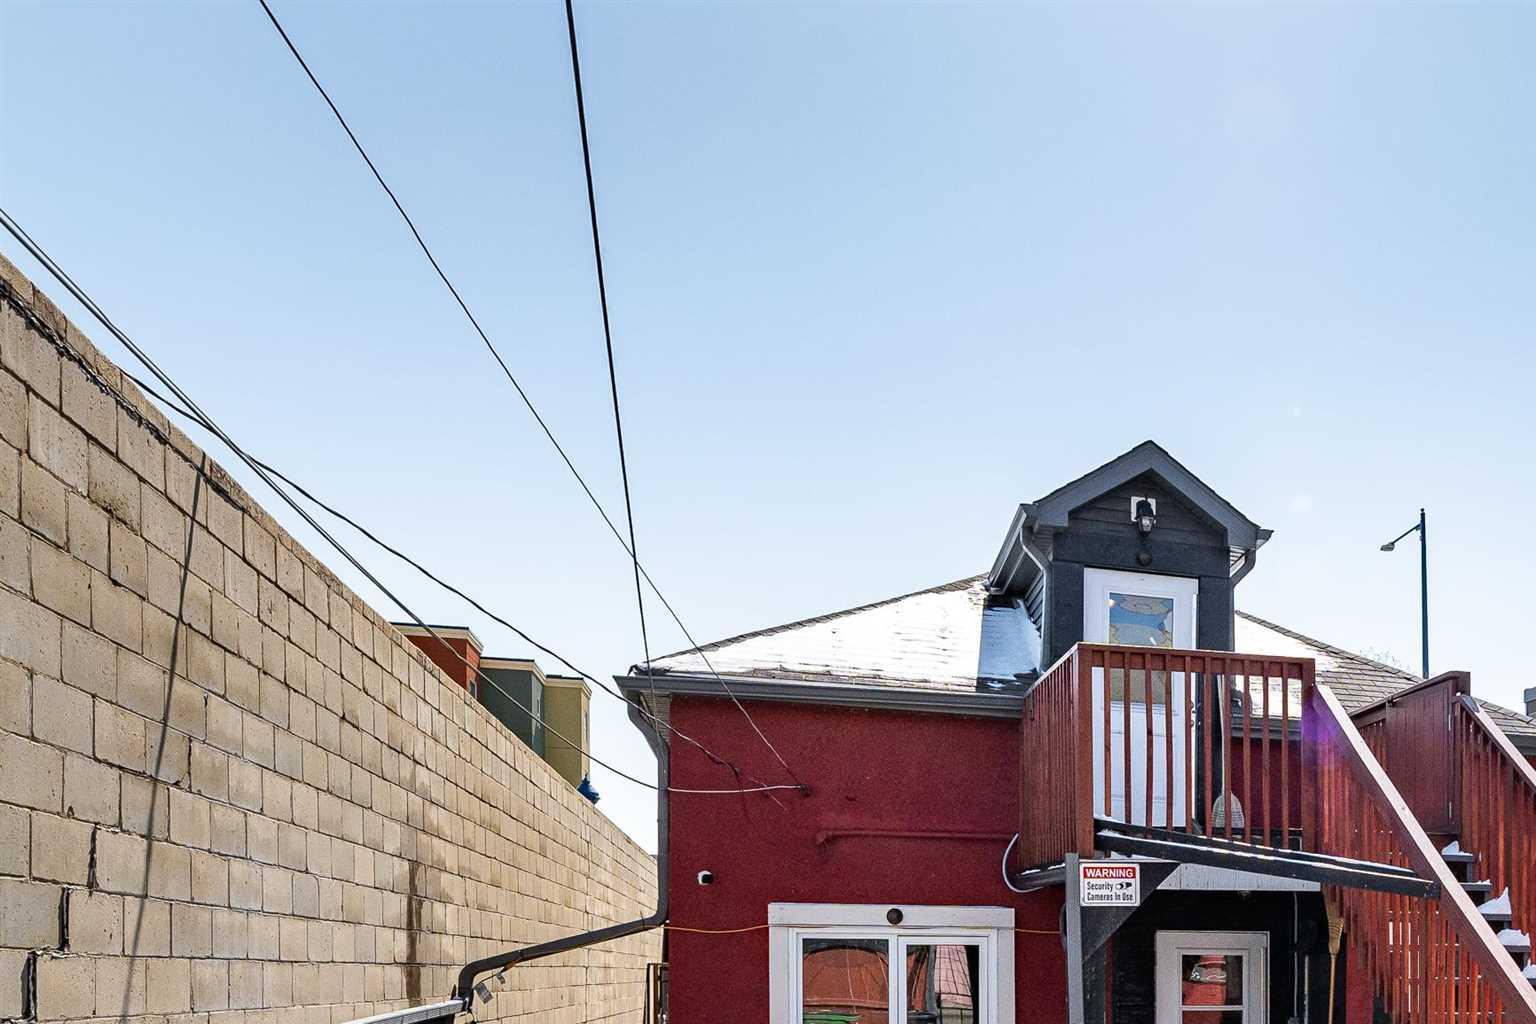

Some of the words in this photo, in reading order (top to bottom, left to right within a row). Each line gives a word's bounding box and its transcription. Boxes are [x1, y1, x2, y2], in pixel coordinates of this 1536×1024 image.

[1086, 869, 1133, 878] WARNING
[1087, 881, 1114, 892] Security
[1087, 892, 1113, 901] Cameras
[1115, 892, 1121, 901] In
[1122, 892, 1134, 901] Use
